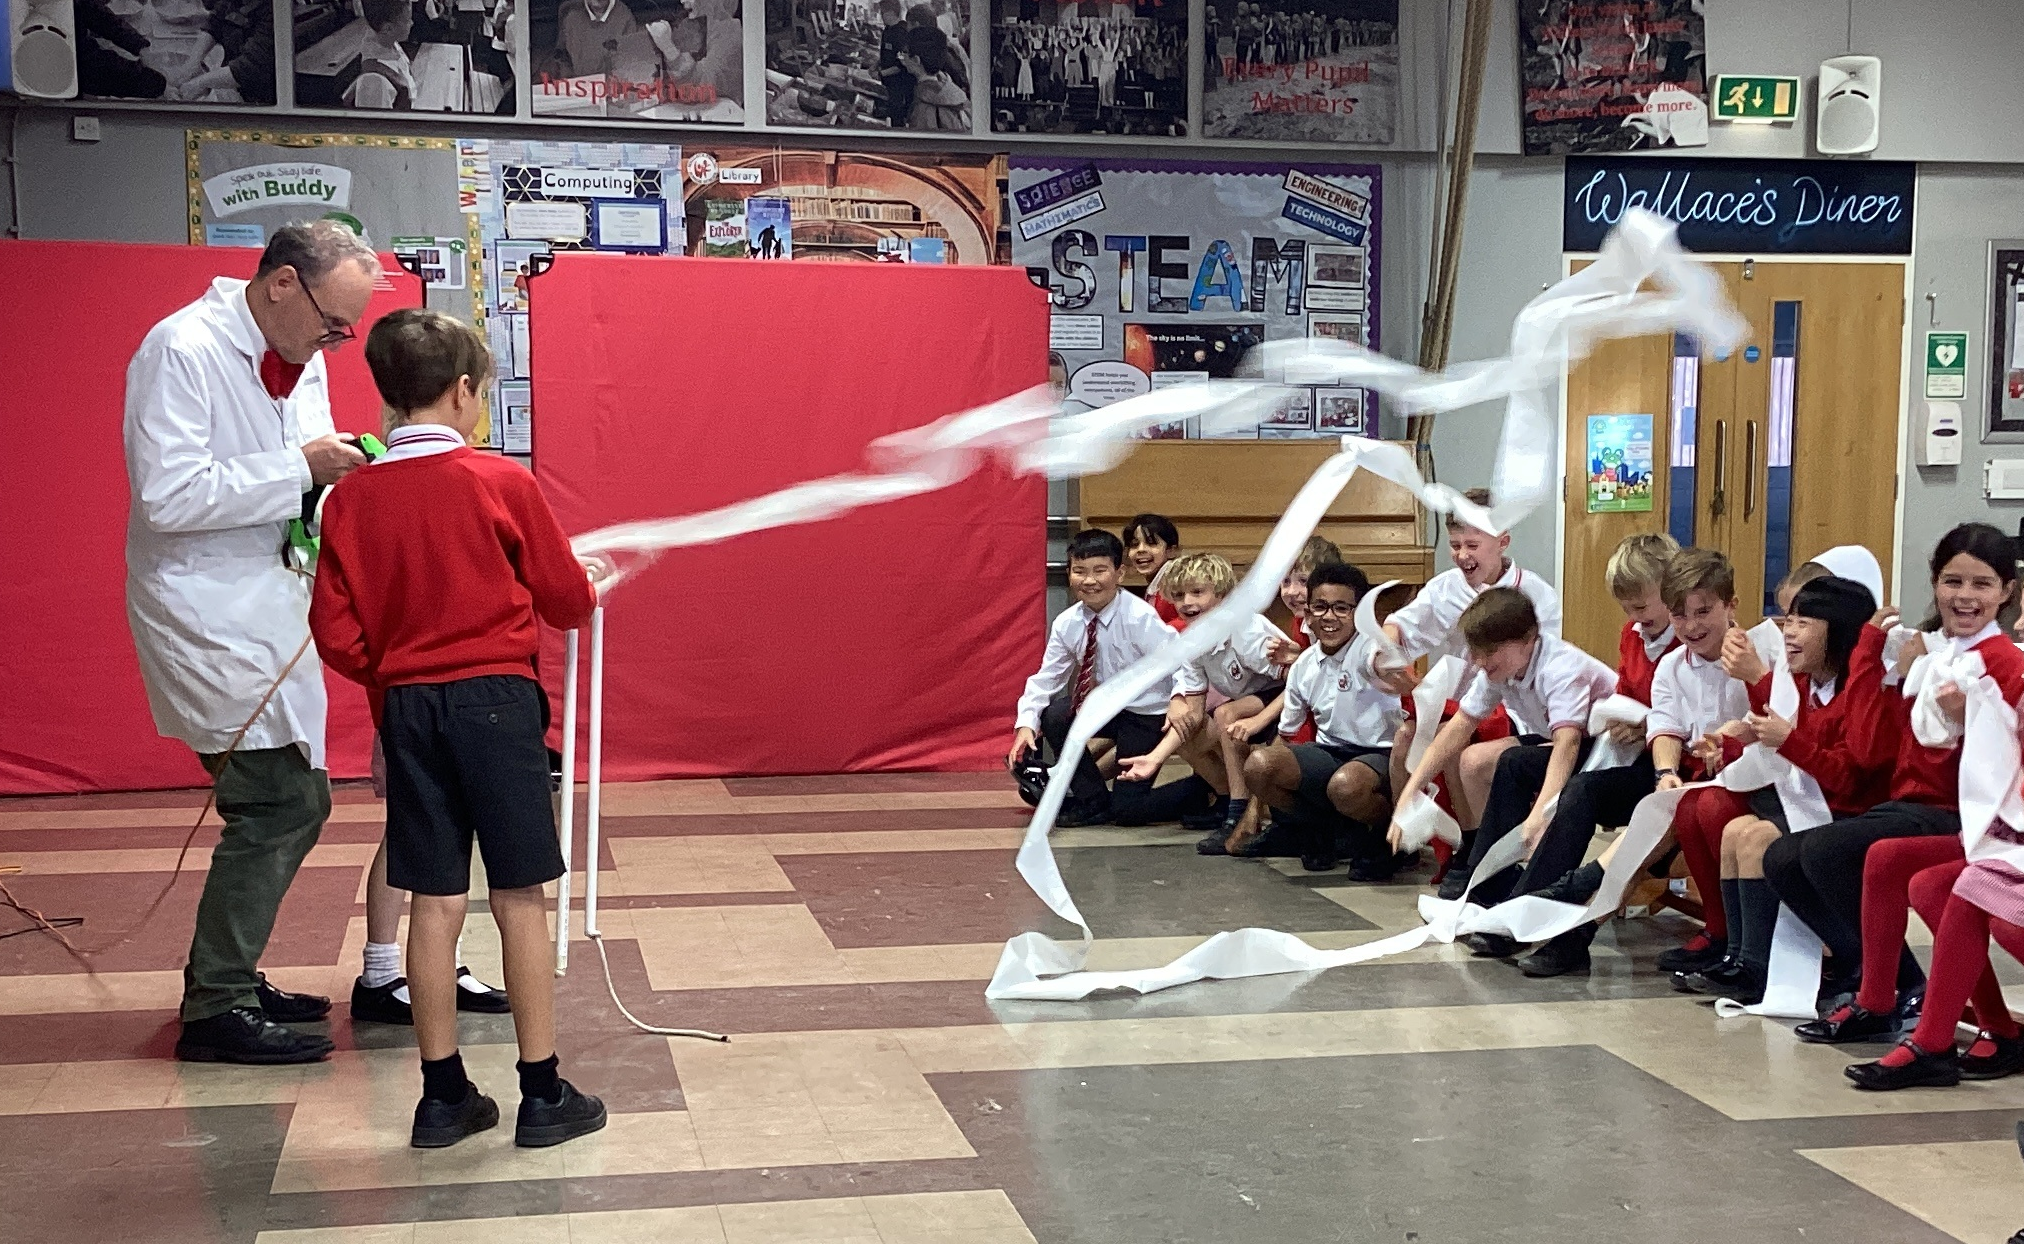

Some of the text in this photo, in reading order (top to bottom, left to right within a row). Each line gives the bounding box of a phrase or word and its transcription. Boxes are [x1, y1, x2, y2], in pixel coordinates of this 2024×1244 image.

[540, 71, 717, 104] Inspiration
[1223, 57, 1370, 88] Every Pupil
[1252, 90, 1355, 115] Matters
[1601, 99, 1653, 116] become
[1657, 101, 1698, 113] more.
[544, 173, 632, 194] Computing
[722, 170, 759, 183] Library
[222, 179, 337, 206] with Buddy
[1291, 176, 1359, 212] ENGINEERING
[1575, 170, 1902, 234] Wallace's Diner
[1289, 202, 1360, 238] TECHNOLOGY
[1049, 229, 1306, 316] STEAM
